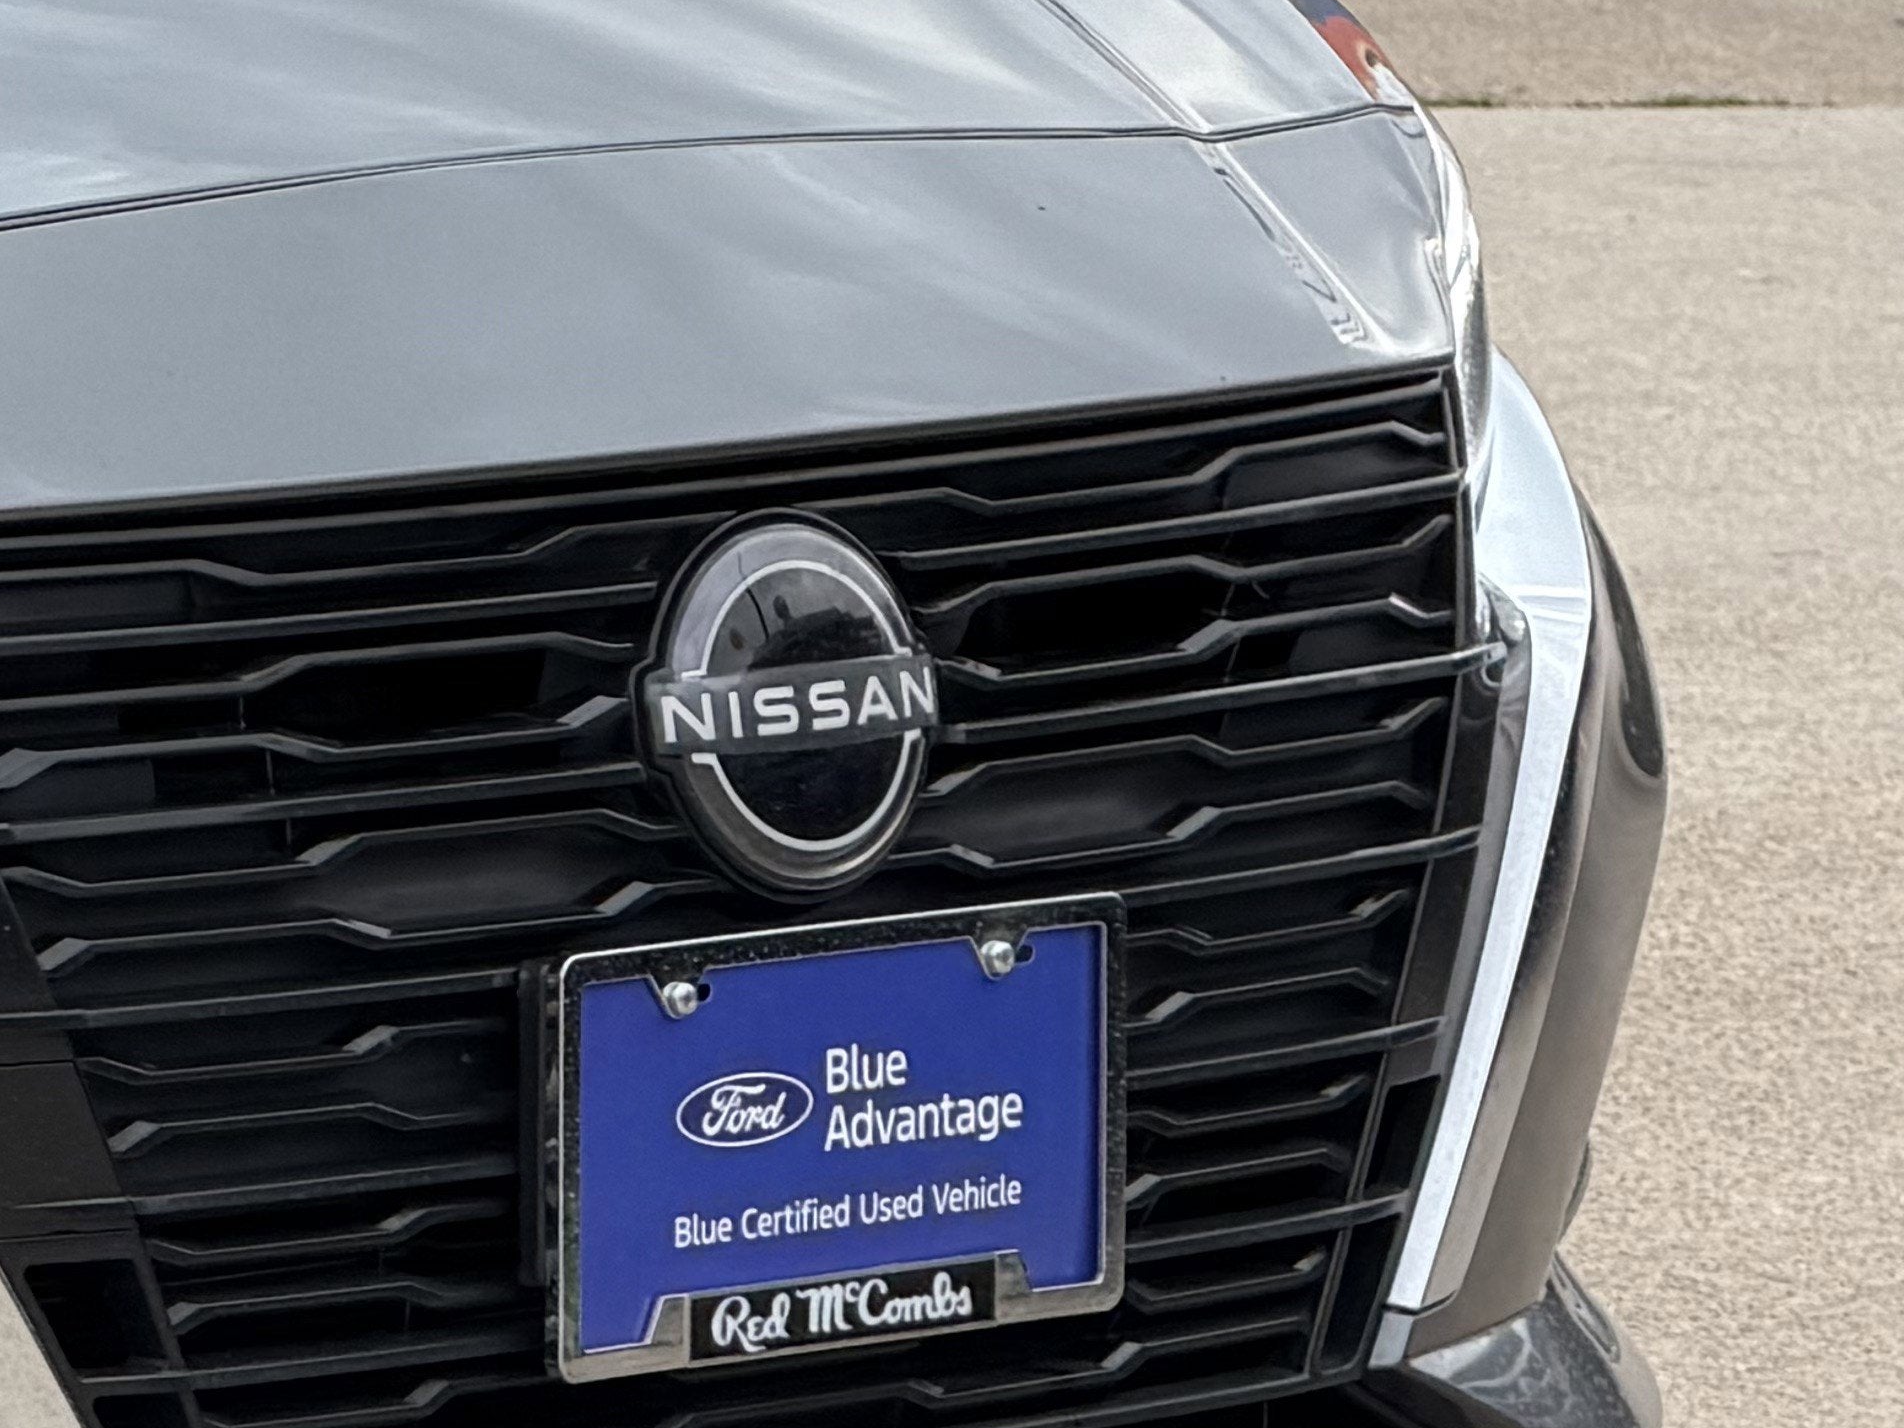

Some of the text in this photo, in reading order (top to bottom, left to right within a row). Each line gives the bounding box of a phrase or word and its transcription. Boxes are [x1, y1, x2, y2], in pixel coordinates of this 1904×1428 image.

[660, 666, 936, 744] NISSAN
[826, 1043, 908, 1094] Blue
[701, 1083, 788, 1137] Ford
[824, 1091, 1024, 1152] Advantage
[674, 1173, 1022, 1248] Blue Certified Used Vehicle
[710, 1270, 973, 1354] Red McCombs
